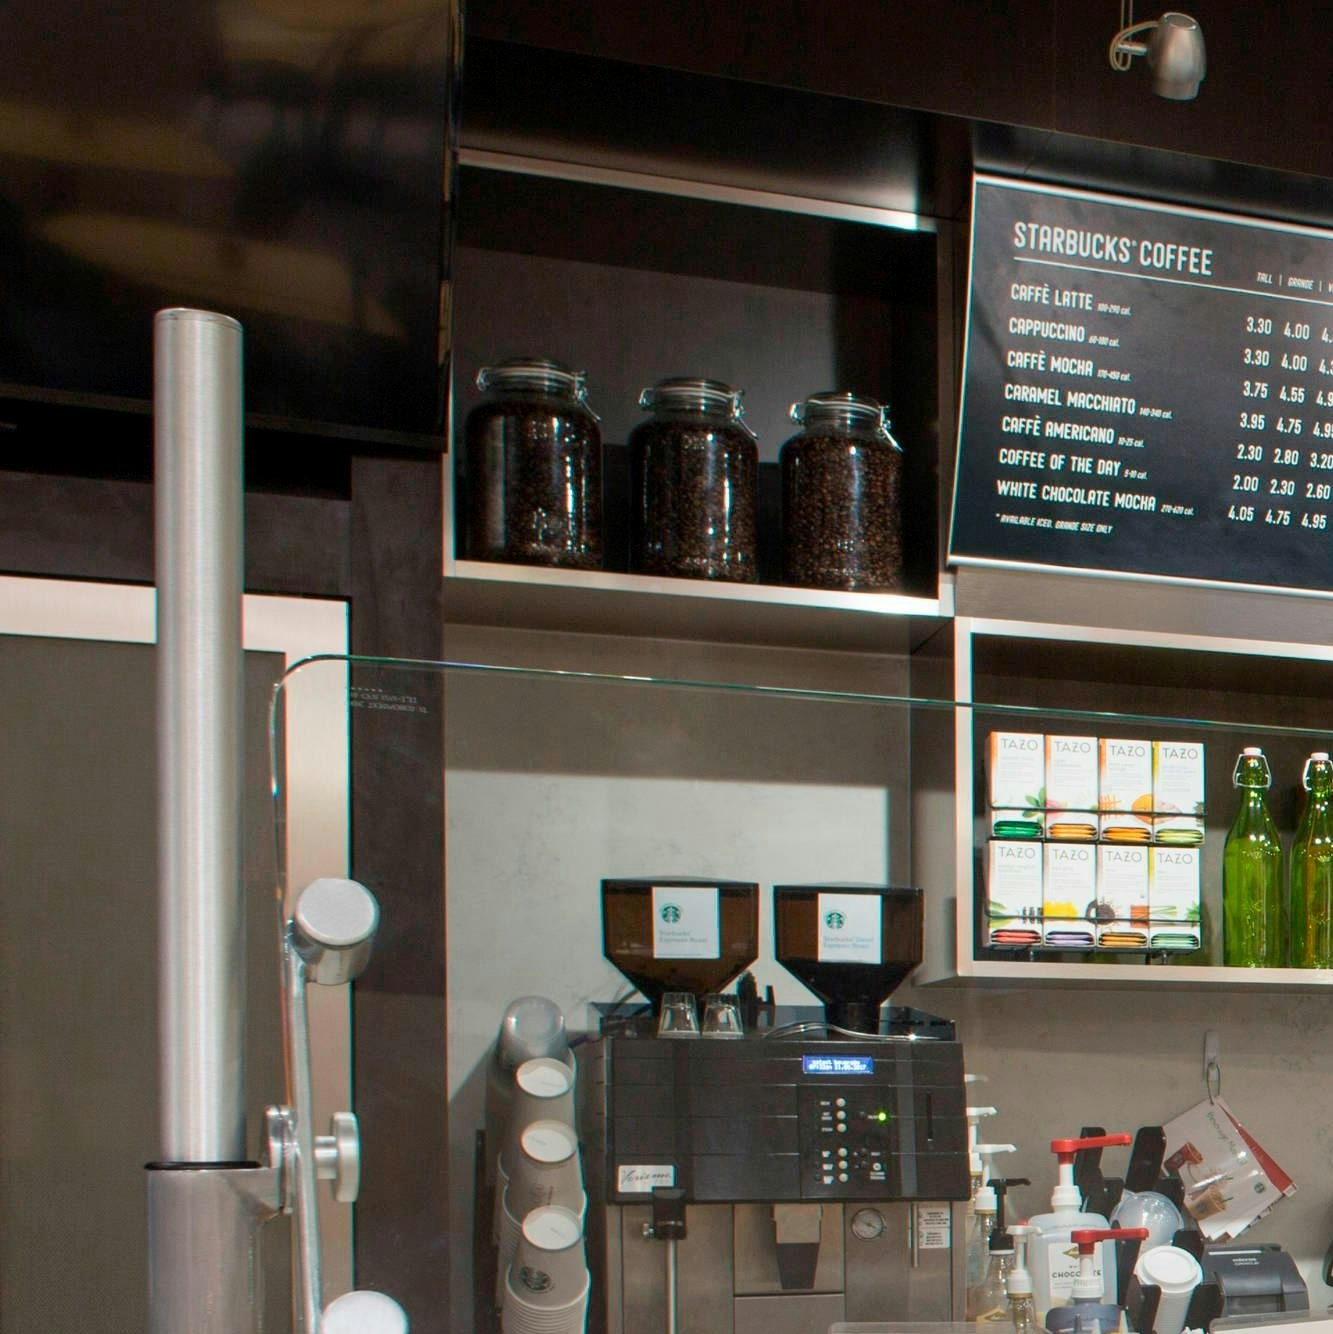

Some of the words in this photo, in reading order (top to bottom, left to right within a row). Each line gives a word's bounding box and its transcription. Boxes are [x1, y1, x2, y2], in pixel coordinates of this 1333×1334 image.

[1140, 241, 1213, 275] COFFEE
[1011, 283, 1050, 304] CAFFÈ
[1055, 290, 1093, 310] LATTE
[1009, 318, 1085, 343] CAPPUCCINO
[1247, 317, 1272, 335] 3.30
[1284, 321, 1310, 340] 4.00
[1008, 350, 1045, 371] CAFFÈ
[1051, 357, 1094, 377] MOCHA
[1005, 384, 1060, 406] CARAMEL
[1068, 392, 1136, 414] MACCHIATO
[1002, 414, 1040, 436] CAFFÈ
[1046, 424, 1114, 444] AMERICANO
[999, 449, 1045, 468] COFFEE
[1050, 455, 1065, 470] OF
[1071, 457, 1093, 474] THE
[1098, 461, 1121, 477] DAY
[997, 479, 1037, 499] WHITE
[1042, 485, 1110, 507] CHOCOLATE
[1115, 495, 1155, 512] MOCHA
[1000, 738, 1038, 751] TAZO
[1054, 740, 1091, 753] TAZO
[1110, 745, 1145, 757] TAZO
[1162, 747, 1198, 759] TAZO
